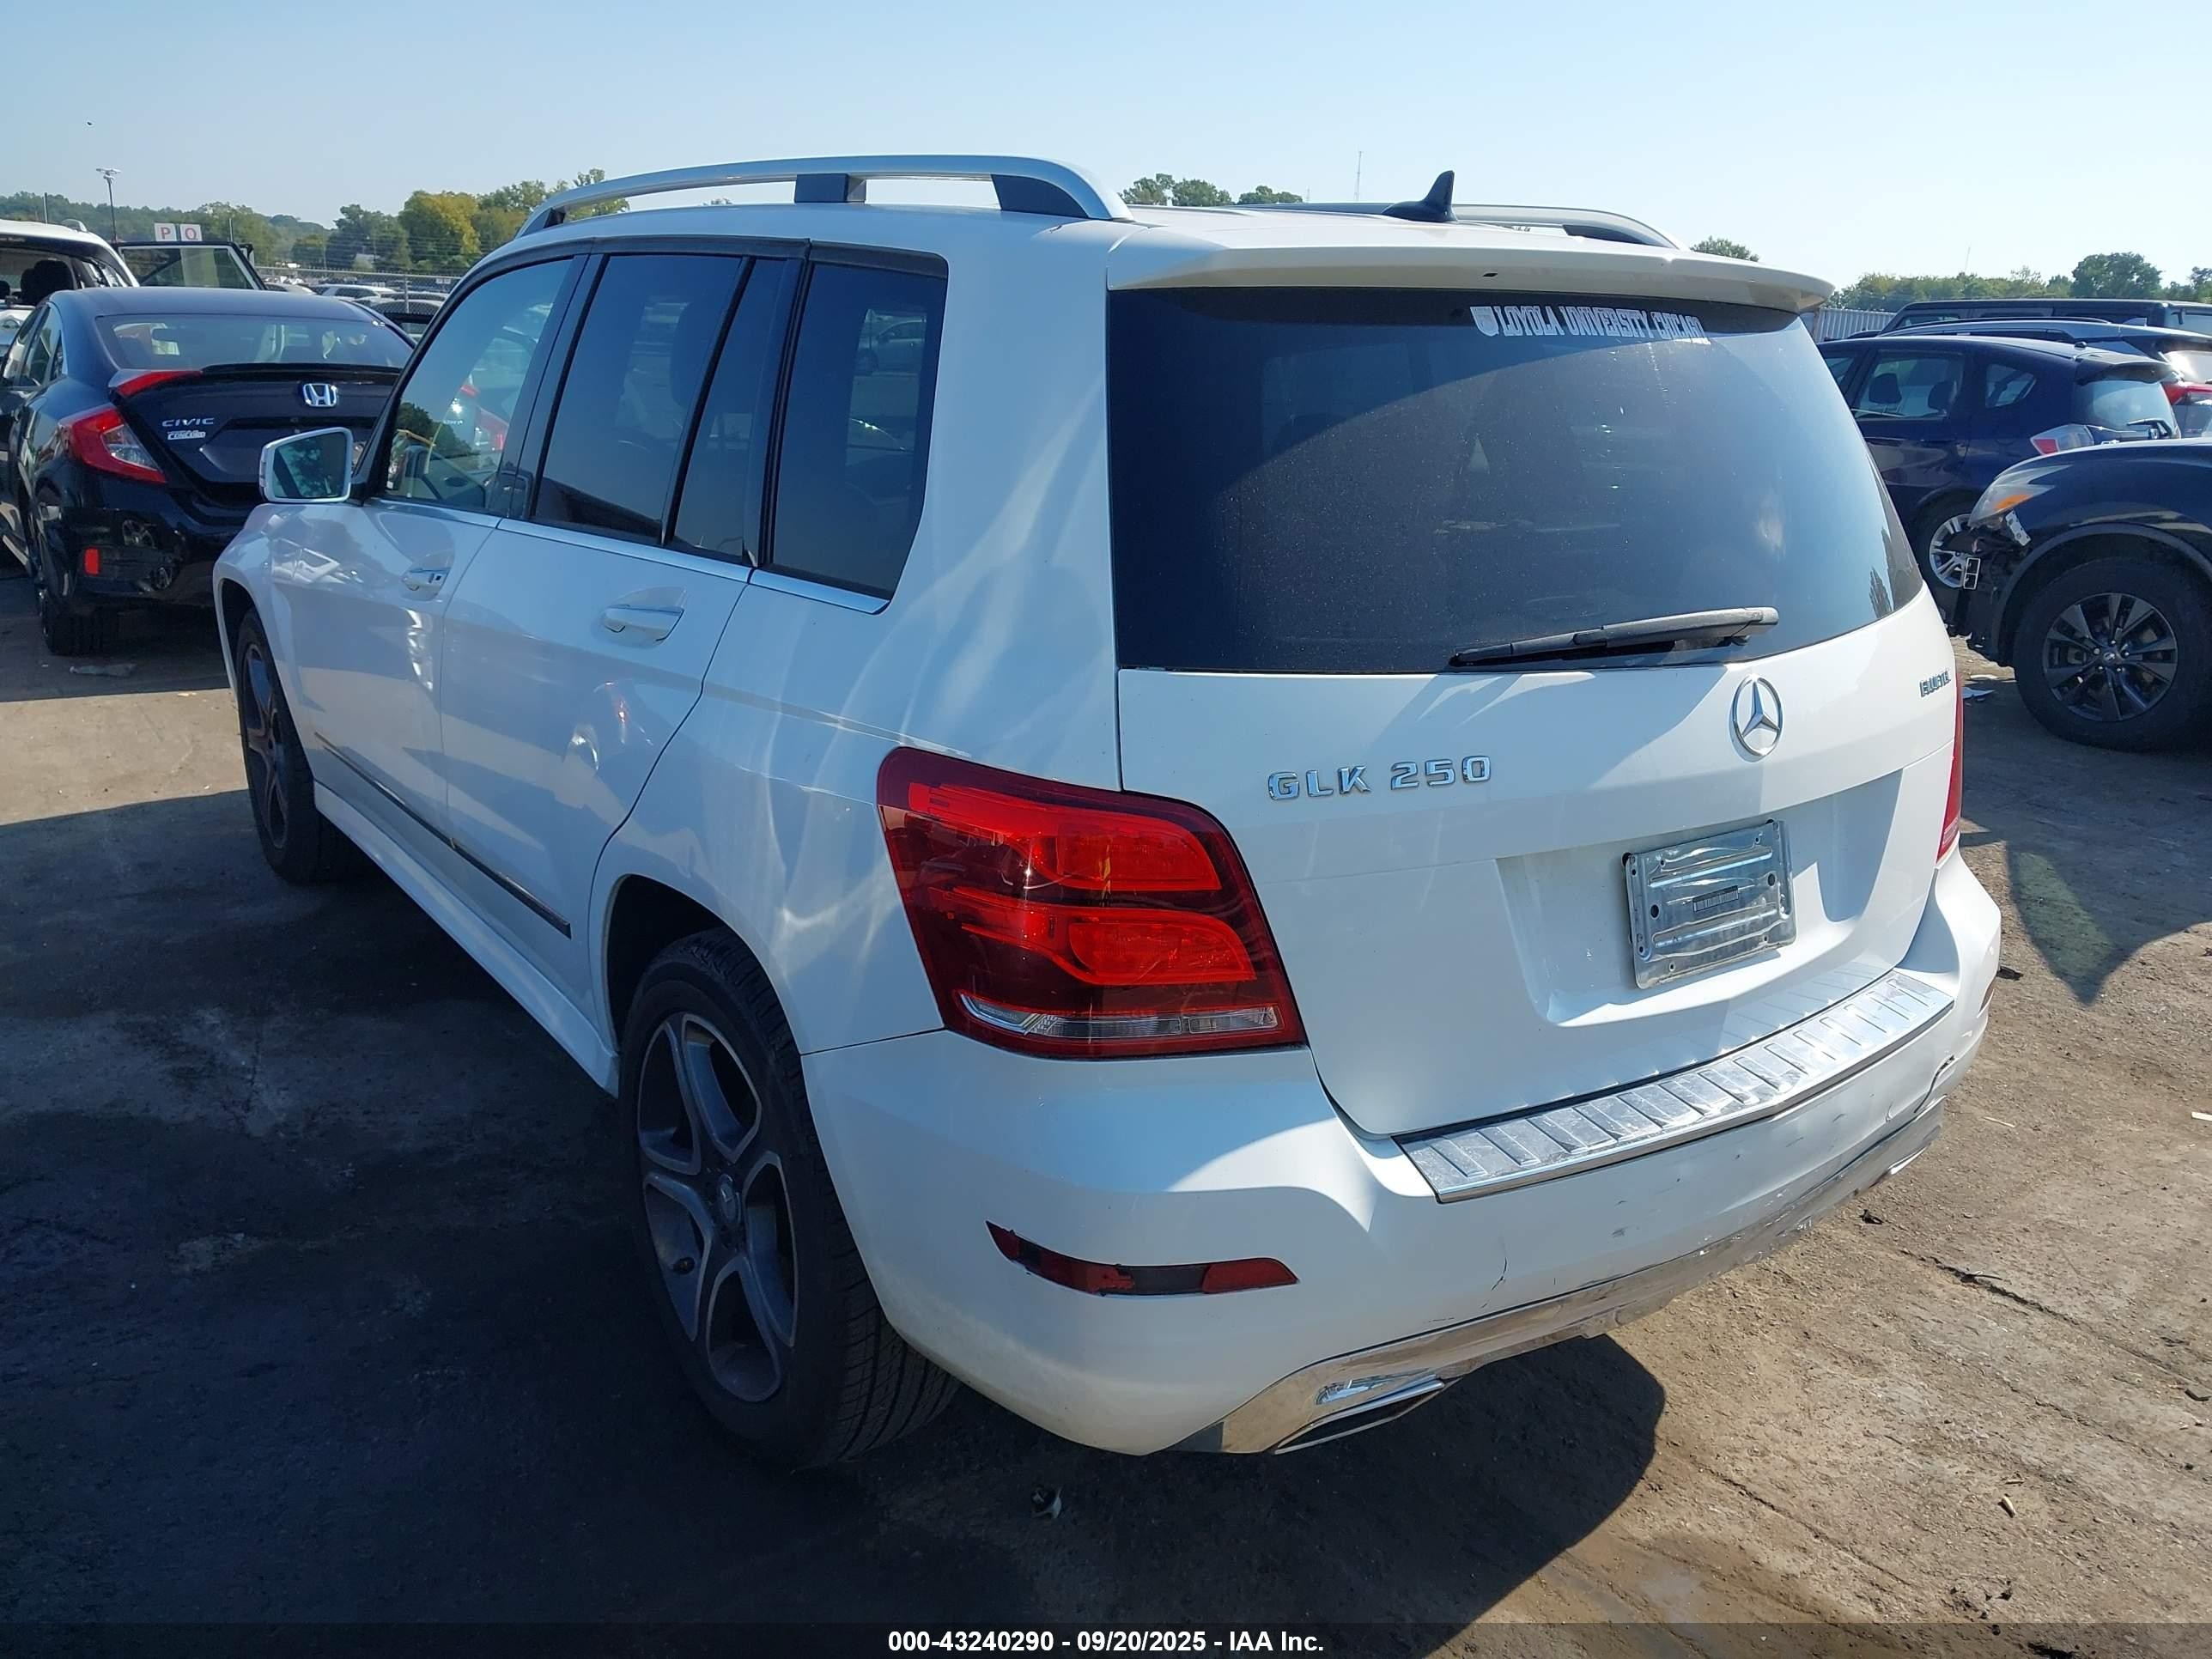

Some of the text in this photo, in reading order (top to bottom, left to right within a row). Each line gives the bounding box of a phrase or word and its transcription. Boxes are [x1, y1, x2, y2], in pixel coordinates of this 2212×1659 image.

[160, 227, 171, 240] P
[1493, 305, 1711, 345] LOYOLA UNIVERSITY CHICAGO
[161, 417, 215, 427] CIVIC
[1267, 755, 1492, 801] GLK 250
